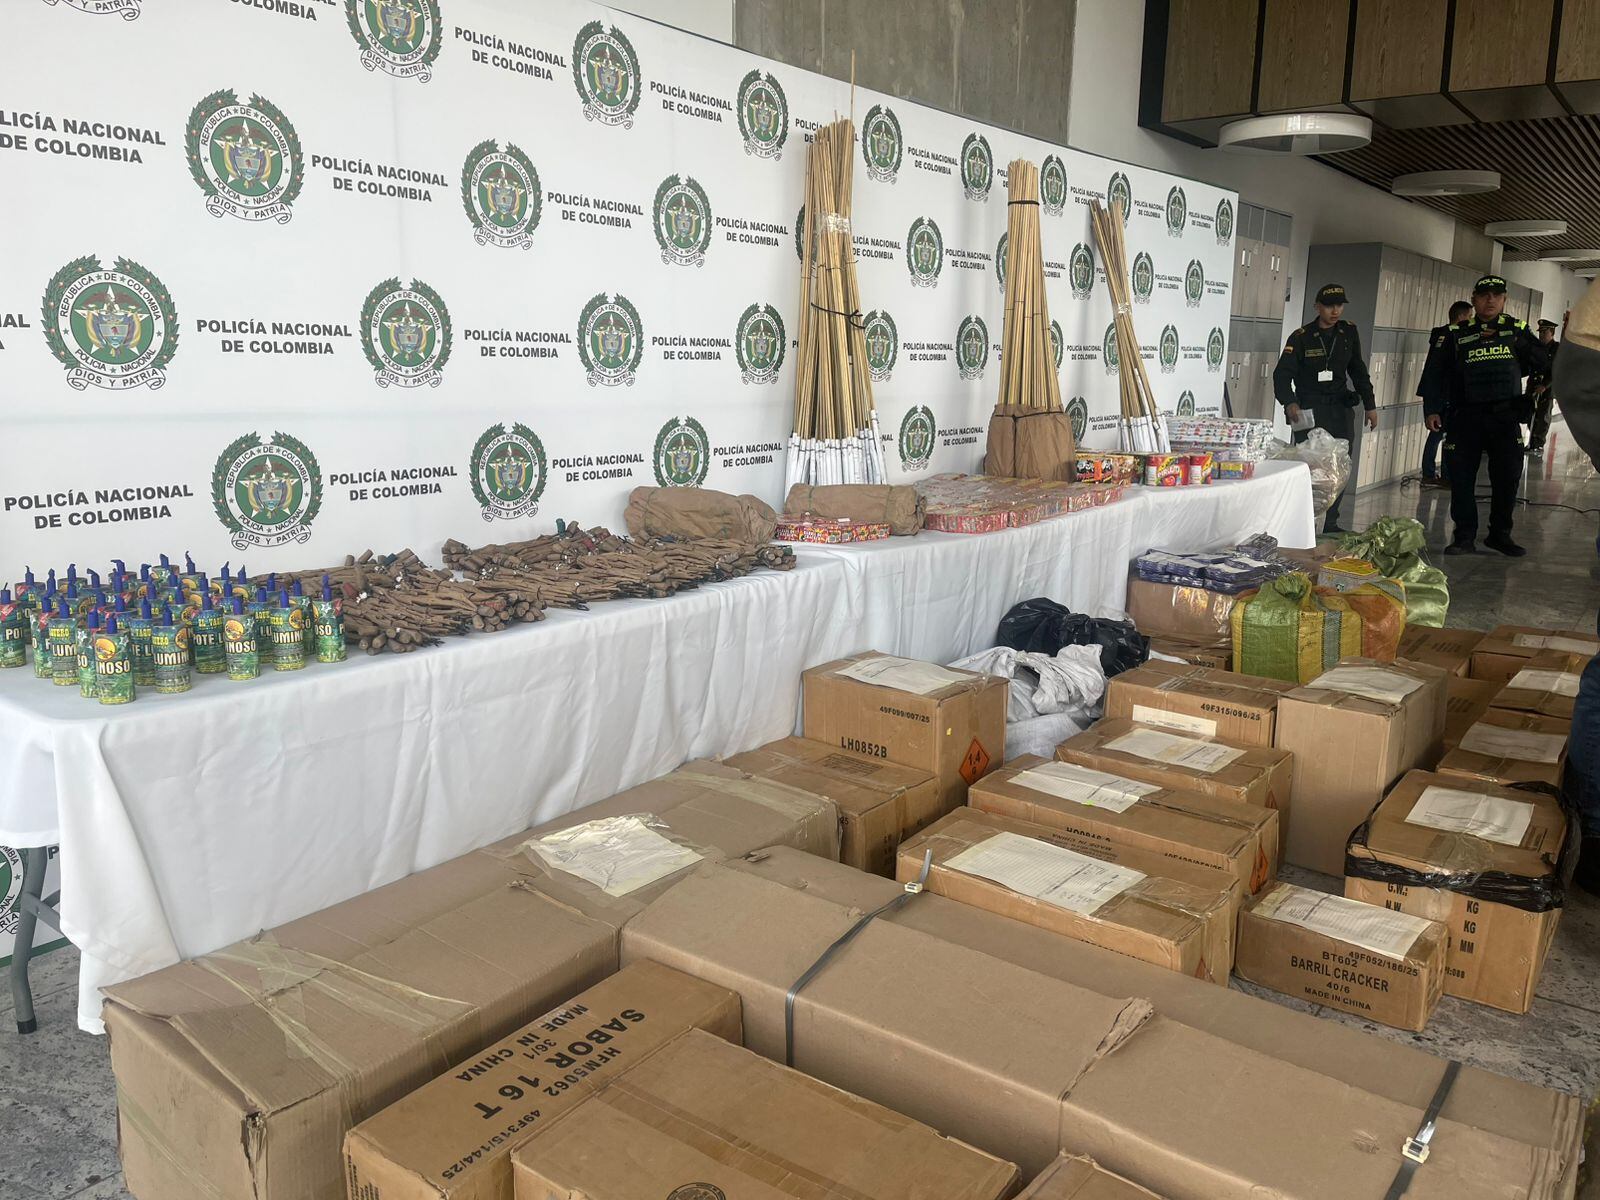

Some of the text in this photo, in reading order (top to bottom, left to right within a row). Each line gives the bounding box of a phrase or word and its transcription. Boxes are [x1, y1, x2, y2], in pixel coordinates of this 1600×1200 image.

[455, 27, 566, 68] POLICÍA NACIONAL
[472, 50, 553, 80] DE COLOMBIA
[650, 81, 732, 111] POLICÍA NACIONAL
[663, 99, 722, 122] DE COLOMBIA
[63, 119, 166, 146] NACIONAL
[201, 107, 289, 158] REPUBLICA DE COLOMBIA
[0, 134, 142, 164] DE COLOMBIA
[312, 155, 448, 187] POLICÍA NACIONAL
[214, 177, 284, 204] POLICIA NACIONAL
[333, 177, 432, 202] DE COLOMBIA
[214, 197, 236, 213] DIOS
[255, 204, 286, 218] PATRIA
[548, 192, 644, 215] POLICÍA NACIONAL
[562, 210, 631, 228] DE COLOMBIA
[716, 217, 788, 235] POLICÍA NACIONAL
[727, 232, 779, 246] DE COLOMBIA
[60, 273, 161, 320] REPUBLICA DE COLOMBIA
[197, 319, 352, 336] POLICÍA NACIONAL
[464, 328, 571, 343] POLICÍA NACIONAL
[222, 340, 334, 354] DE COLOMBIA
[481, 346, 558, 358] DE COLOMBIA
[652, 336, 731, 347] POLICÍA NACIONAL
[1468, 345, 1510, 358] POLICÍA
[75, 349, 156, 372] POLICIA NACIONAL
[664, 351, 721, 360] DE COLOMBIA
[76, 369, 102, 383] DIOS
[123, 369, 158, 387] PATRIA
[714, 442, 782, 456] POLICÍA NACIONAL
[227, 450, 256, 488] REPUBLICA
[282, 450, 308, 483] COLOMBIA
[553, 454, 644, 468] POLICÍA NACIONAL
[723, 455, 773, 467] DE COLOMBIA
[330, 466, 457, 486] POLICÍA NACIONAL
[566, 468, 632, 482] DE COLOMBIA
[4, 485, 193, 511] POLICÍA NACIONAL
[350, 483, 442, 501] DE COLOMBIA
[34, 505, 172, 529] DE COLOMBIA
[238, 508, 304, 531] POLICIA NACIONAL
[239, 532, 260, 543] DIOS
[277, 525, 305, 543] PATRIA
[1201, 704, 1260, 720] 49F315/096/25
[841, 736, 887, 758] LH0852B
[968, 752, 980, 766] 1.4
[1466, 900, 1479, 914] KG
[1464, 920, 1476, 934] KG
[1460, 940, 1474, 954] MM
[1322, 952, 1358, 968] BT602
[1349, 952, 1418, 976] 49F052/186/25
[1291, 956, 1388, 992] BARRIL CRACKER
[1326, 982, 1350, 993] 40/6
[1304, 987, 1372, 1010] MADE IN CHINA
[456, 1004, 588, 1082] MADE IN CHINA
[524, 1038, 557, 1060] 36/1
[474, 1009, 645, 1120] SABOR 16 T
[543, 1046, 621, 1096] HFM5062
[442, 1109, 540, 1180] 49F315/144/25
